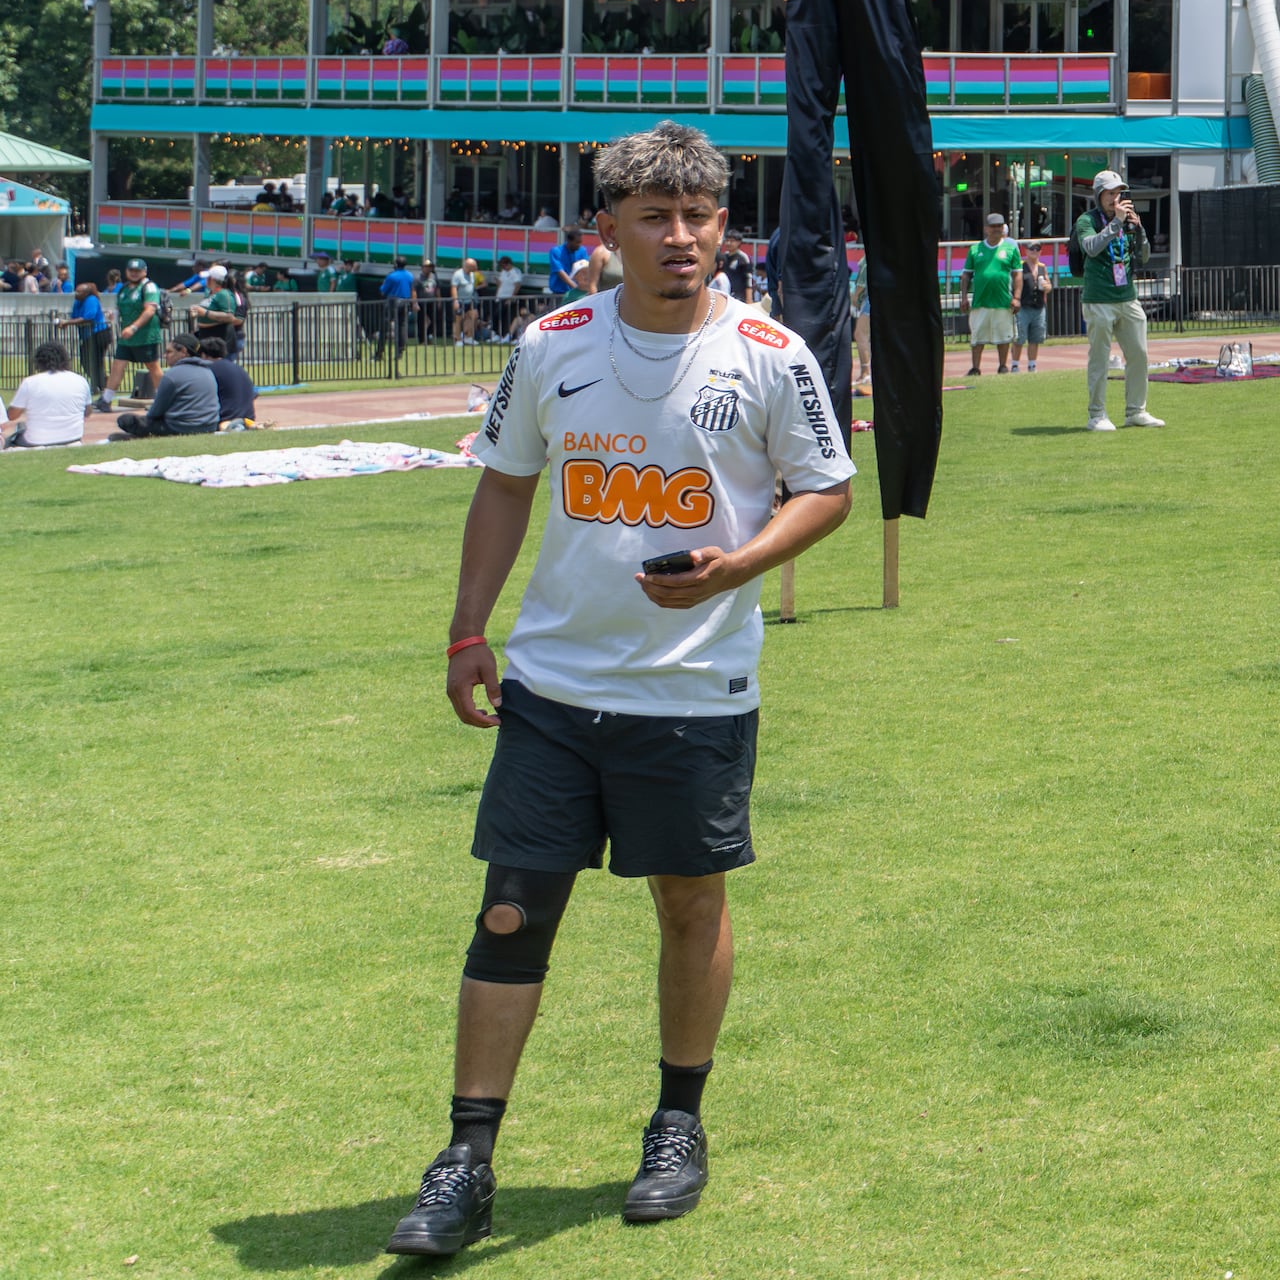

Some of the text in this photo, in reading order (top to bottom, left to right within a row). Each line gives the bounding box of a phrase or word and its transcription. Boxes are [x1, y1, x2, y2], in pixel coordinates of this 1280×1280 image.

[541, 314, 590, 329] SEARA
[739, 323, 784, 348] SEARA
[789, 363, 837, 460] NETSHOES
[563, 431, 647, 455] BANCO
[561, 458, 715, 530] BMG
